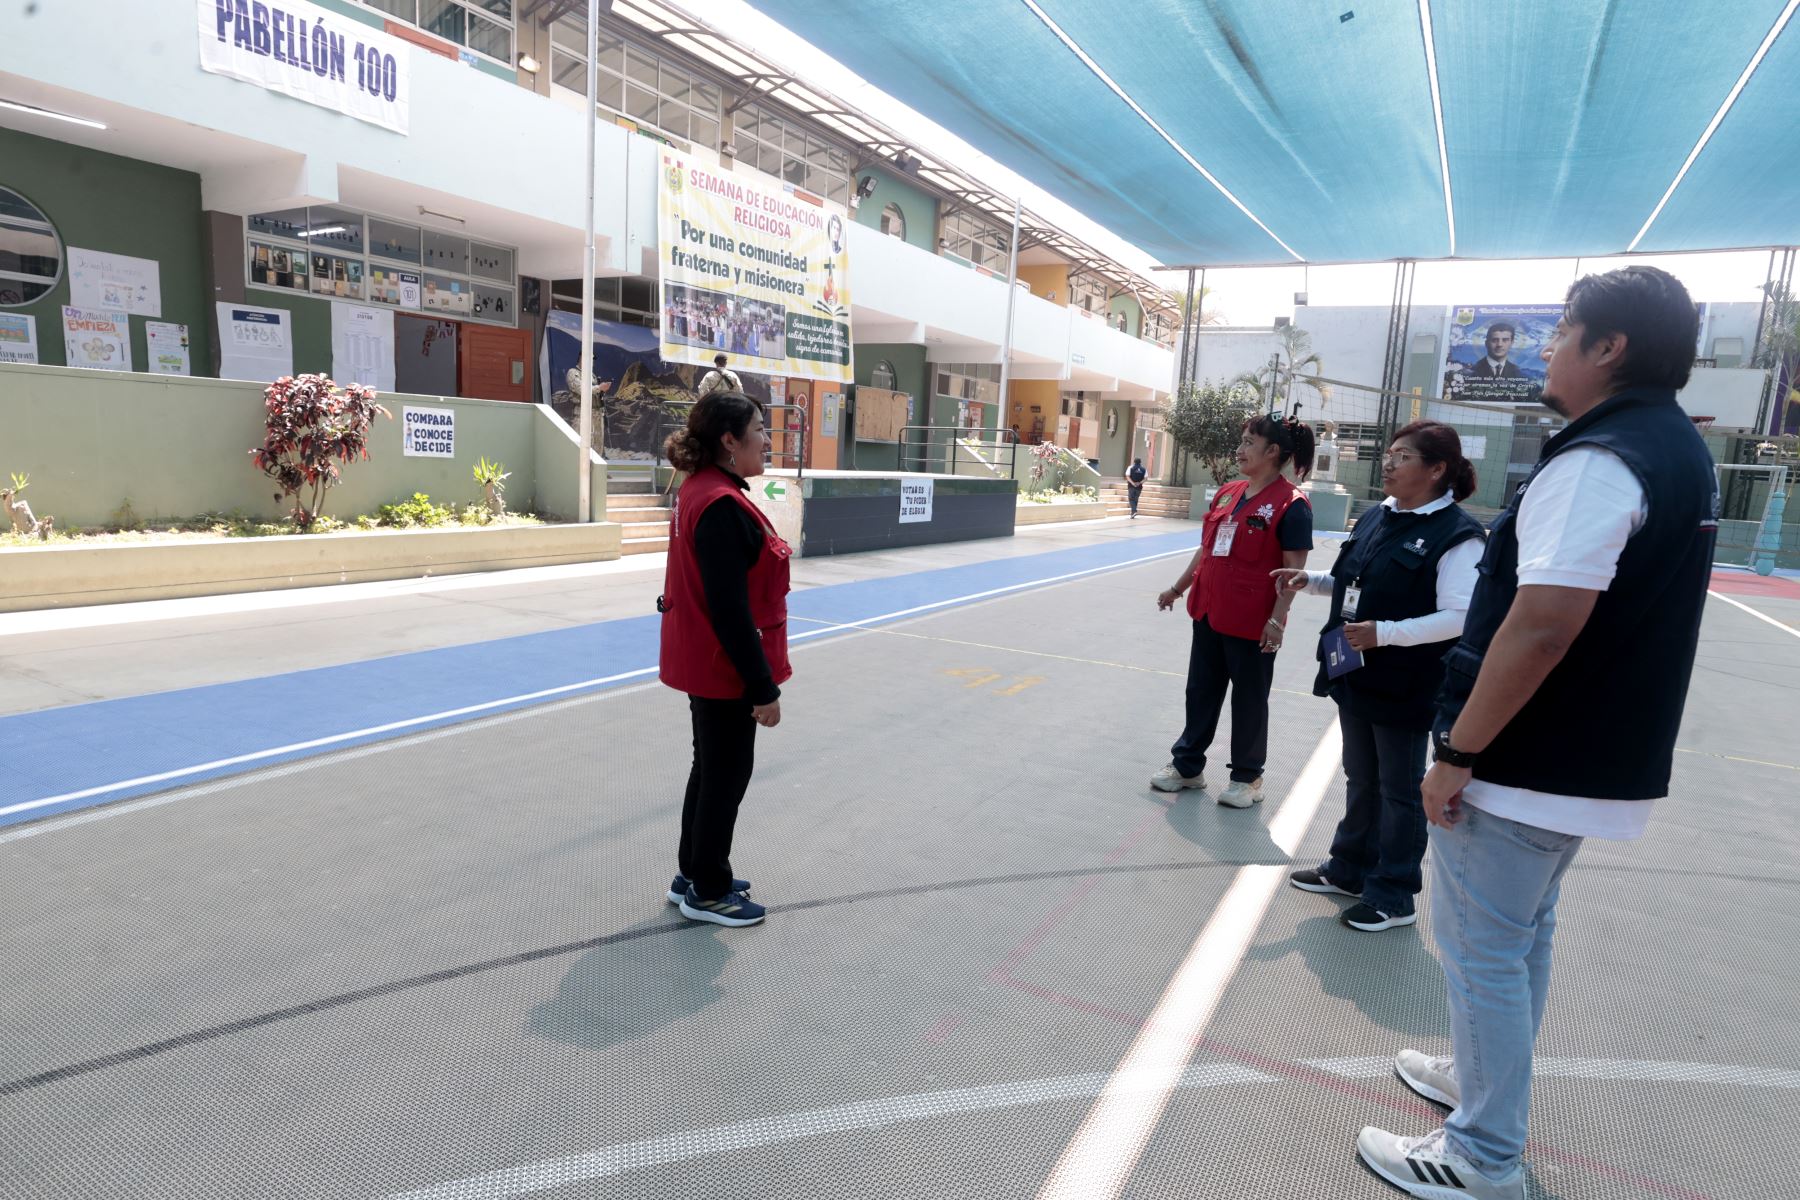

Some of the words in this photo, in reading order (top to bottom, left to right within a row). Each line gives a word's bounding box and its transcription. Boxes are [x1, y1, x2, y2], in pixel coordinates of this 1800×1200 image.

[216, 0, 345, 83] PABELLÓN
[354, 41, 397, 103] 100
[690, 169, 744, 202] SEMANA
[746, 188, 760, 208] DE
[763, 195, 823, 230] EDUCACIÓN
[734, 206, 791, 239] RELIGIOSA
[709, 233, 735, 253] una
[739, 241, 808, 273] comunidad
[671, 246, 730, 278] fraterna
[734, 266, 741, 285] y
[406, 412, 453, 426] COMPARA
[414, 428, 453, 441] CONOCE
[415, 441, 452, 453] DECIDE
[902, 507, 907, 516] DE
[906, 496, 912, 505] TU
